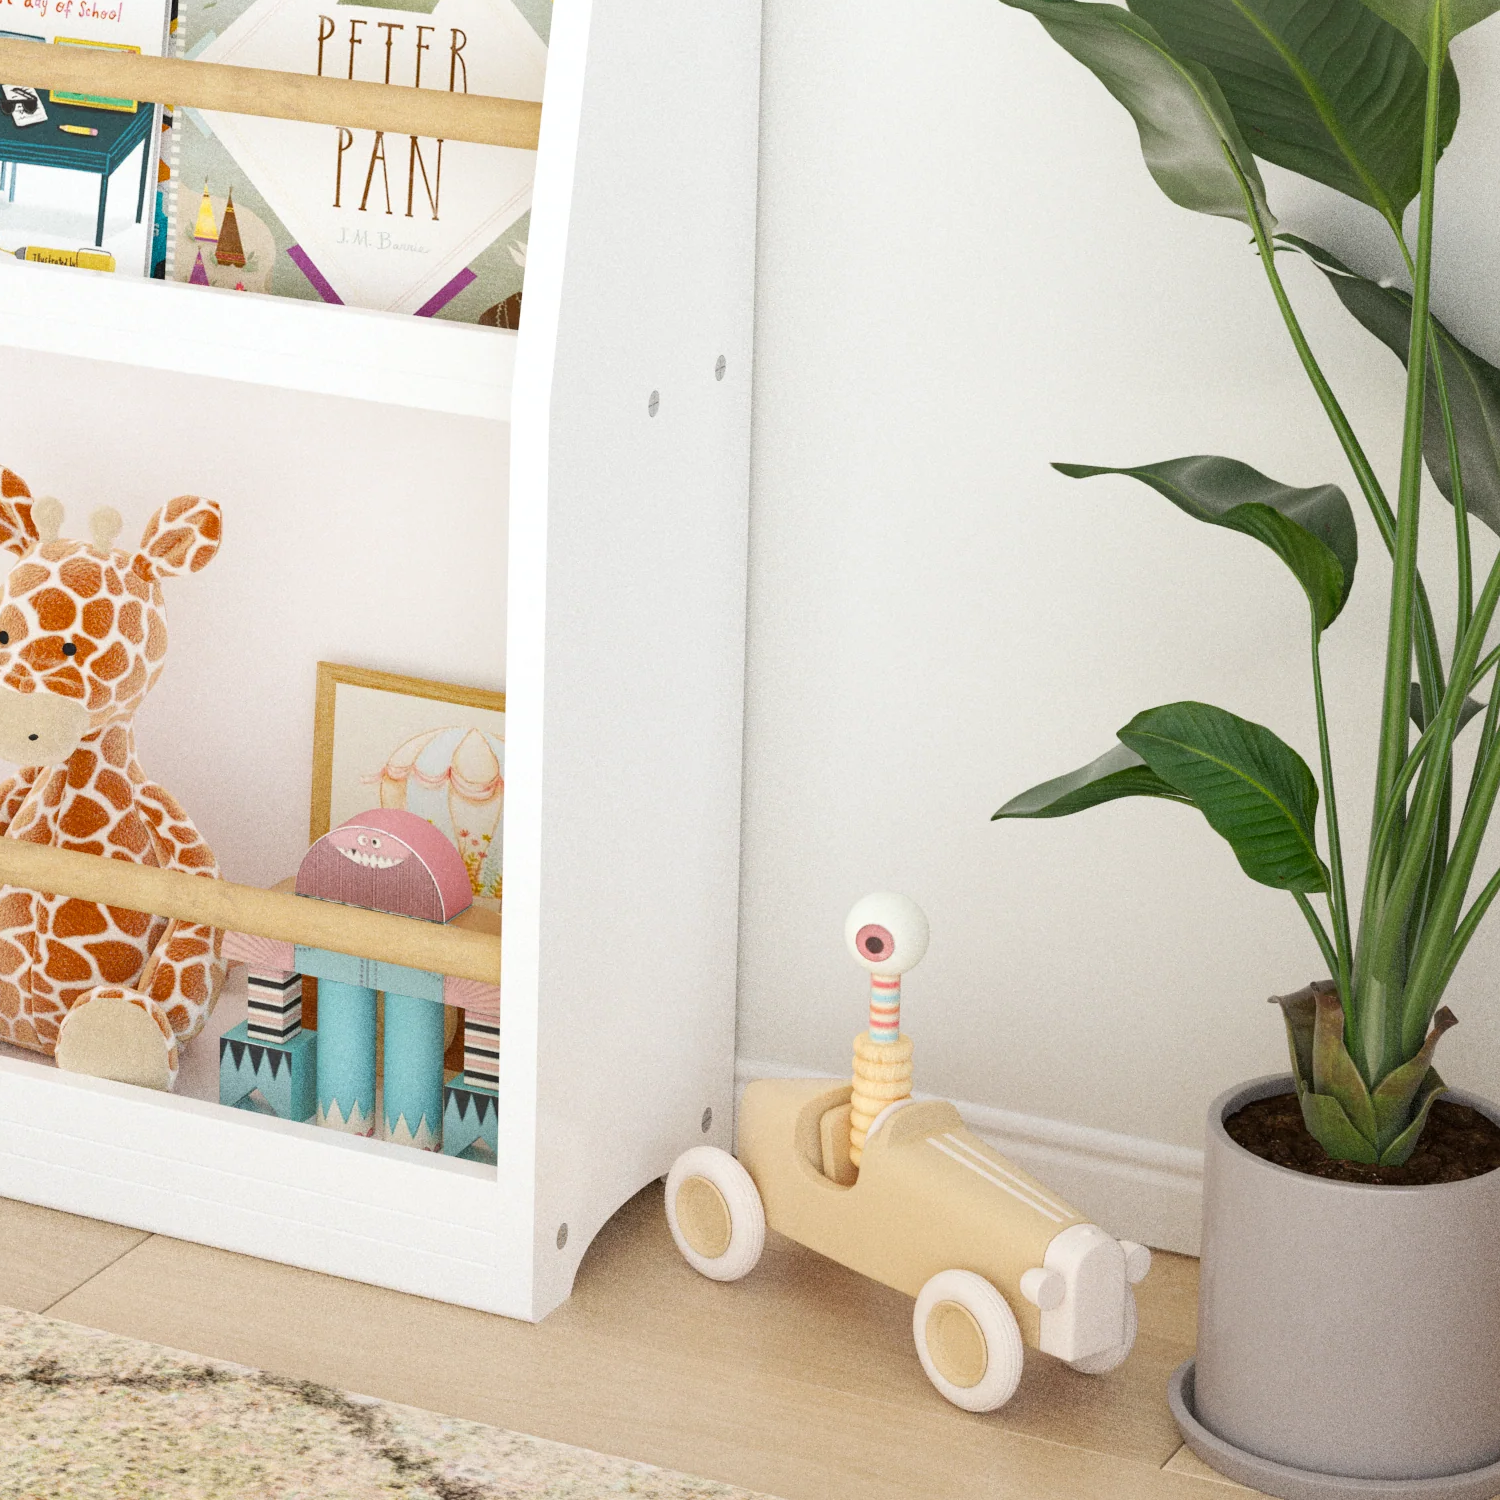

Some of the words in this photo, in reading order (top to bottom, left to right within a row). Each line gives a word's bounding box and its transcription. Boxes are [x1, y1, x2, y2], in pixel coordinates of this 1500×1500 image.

[55, 1, 72, 18] of
[317, 15, 467, 94] PETER
[332, 126, 445, 221] PAN
